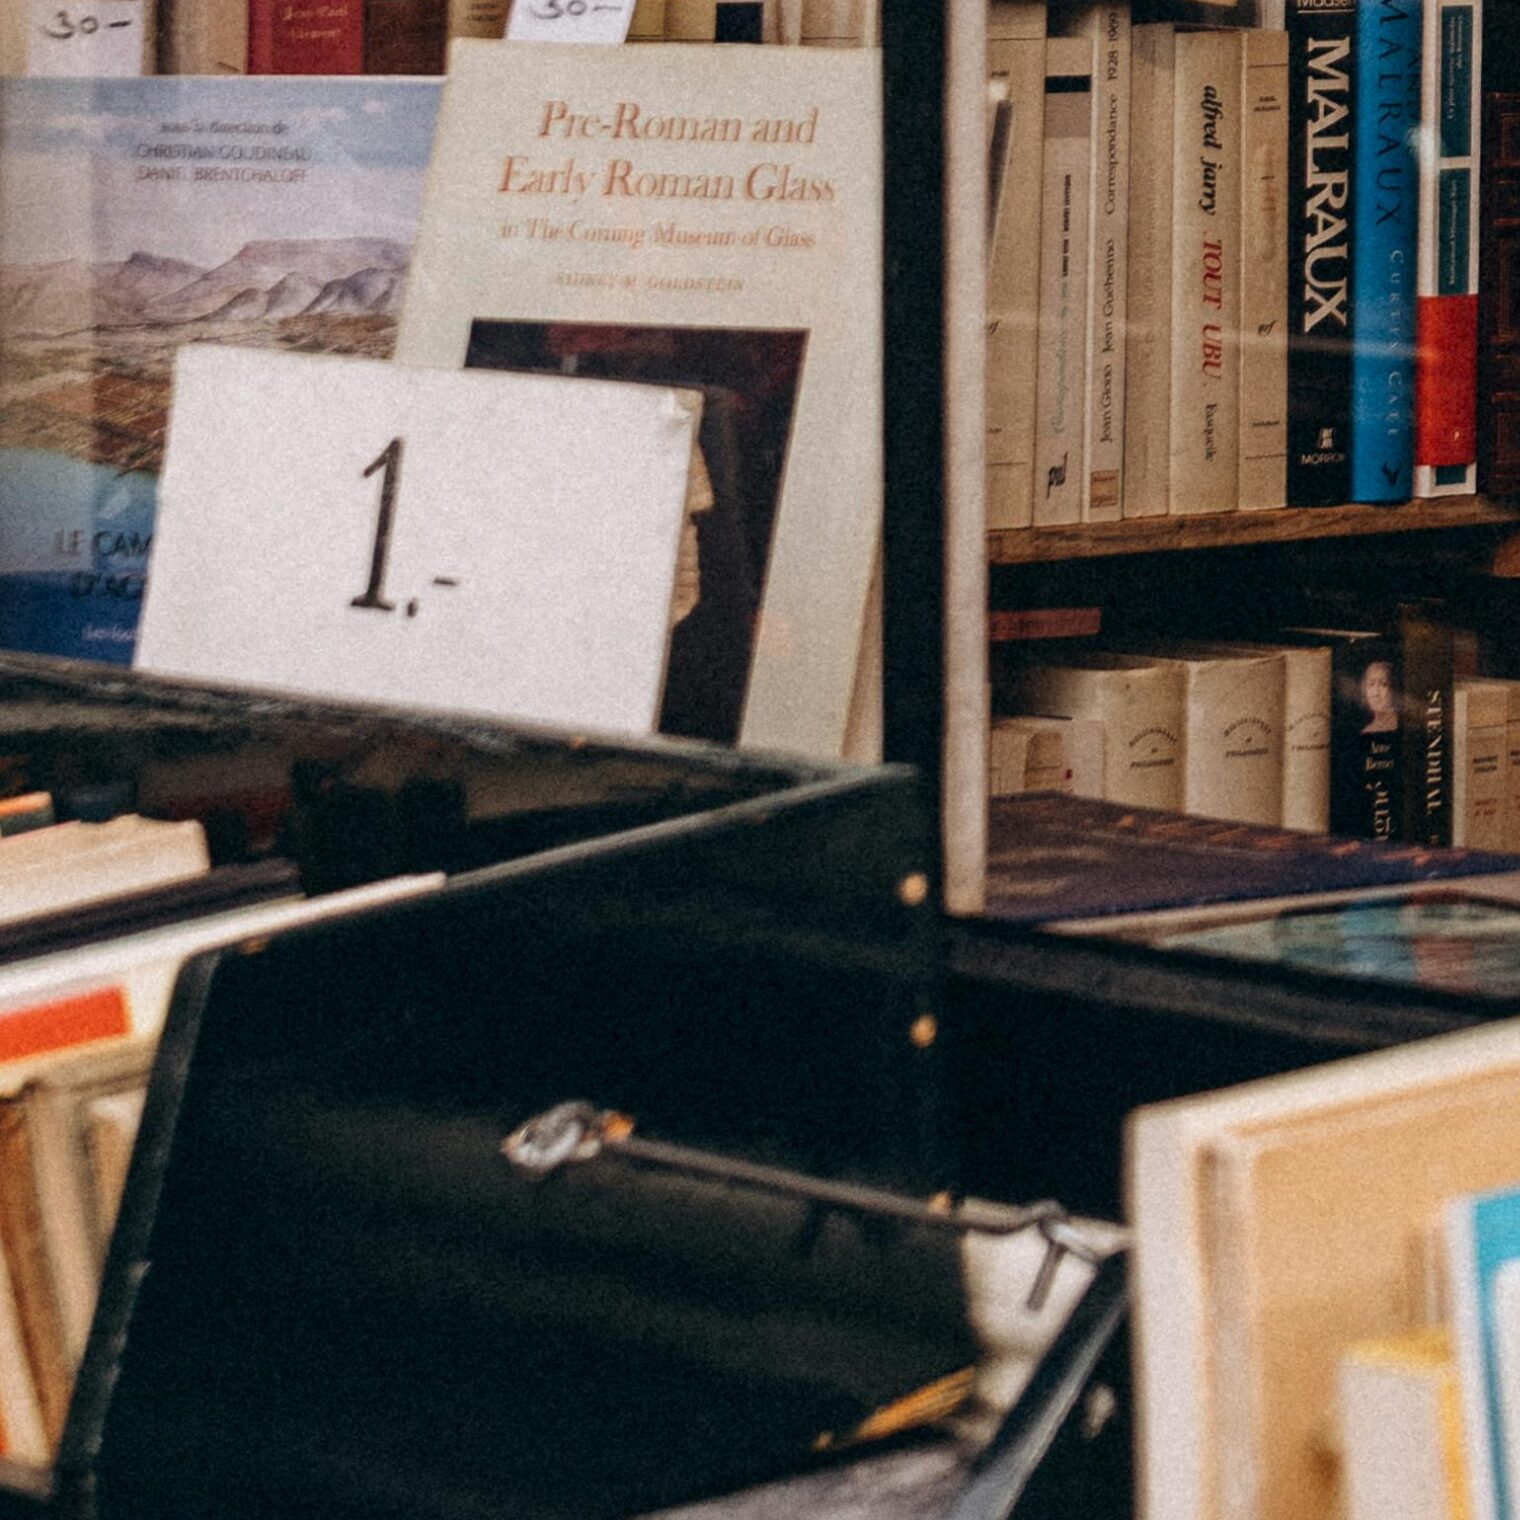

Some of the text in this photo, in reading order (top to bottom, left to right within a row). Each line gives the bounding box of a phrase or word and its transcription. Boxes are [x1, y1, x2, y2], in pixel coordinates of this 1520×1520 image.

[537, 99, 820, 145] Pre-Roman and
[133, 141, 215, 159] CHRISTIAN
[1103, 93, 1119, 217] Correspondance
[497, 155, 836, 205] Early Roman Glass
[1303, 34, 1352, 337] MALRAUX
[526, 217, 563, 243] The
[653, 221, 736, 247] Museum
[741, 223, 765, 246] of
[764, 224, 818, 250] Glass
[1102, 321, 1115, 354] Jean
[1101, 408, 1115, 444] Jean
